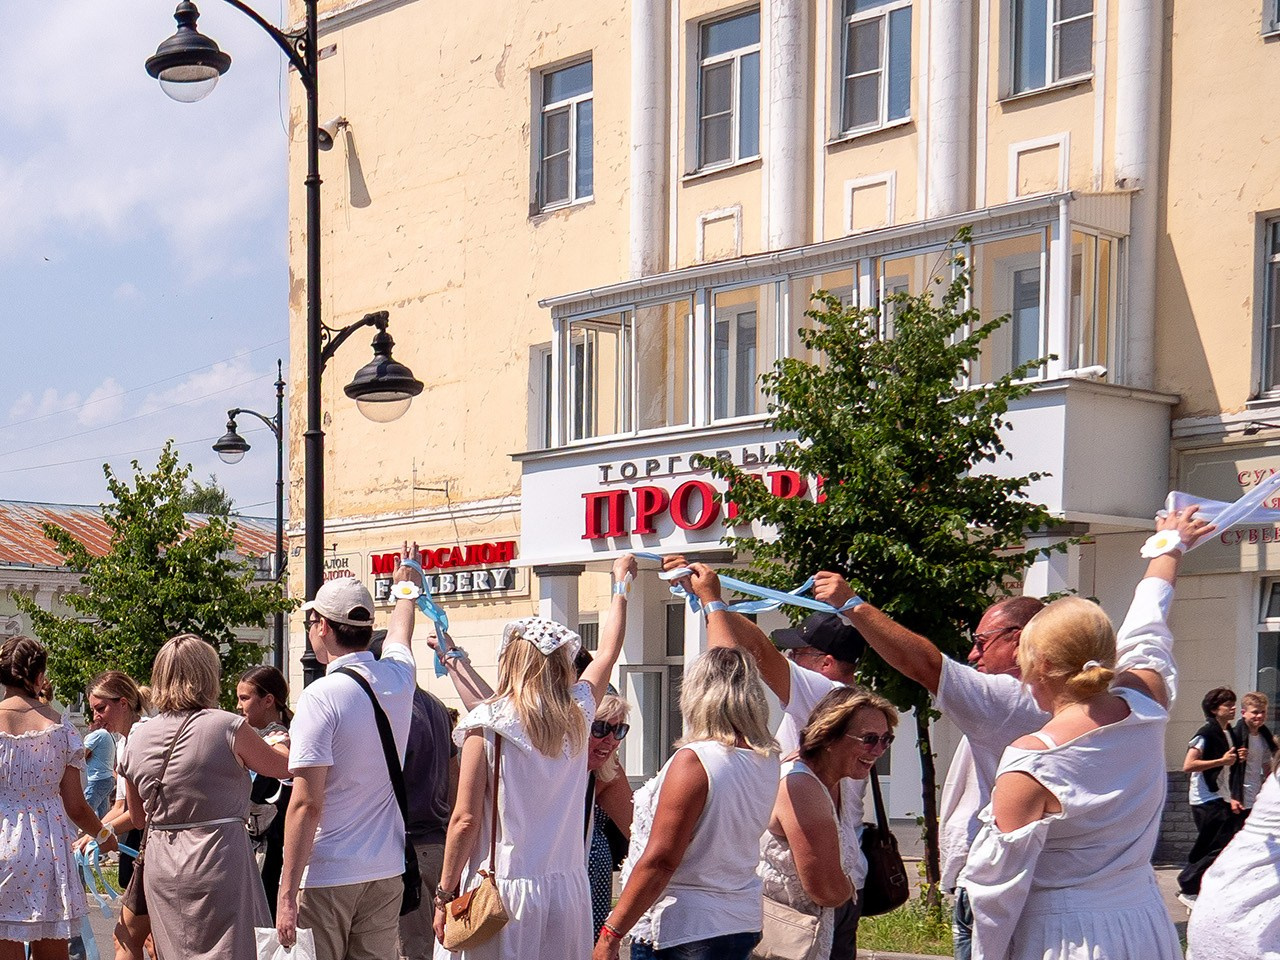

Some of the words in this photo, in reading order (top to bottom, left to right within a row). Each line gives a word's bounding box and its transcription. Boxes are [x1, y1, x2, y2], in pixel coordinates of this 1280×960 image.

[1237, 468, 1276, 487] СУ
[1220, 527, 1280, 546] СУВЕ
[323, 557, 349, 570] АЛОН
[371, 541, 516, 575] МОСАЛОН
[376, 568, 509, 599] FLBERY
